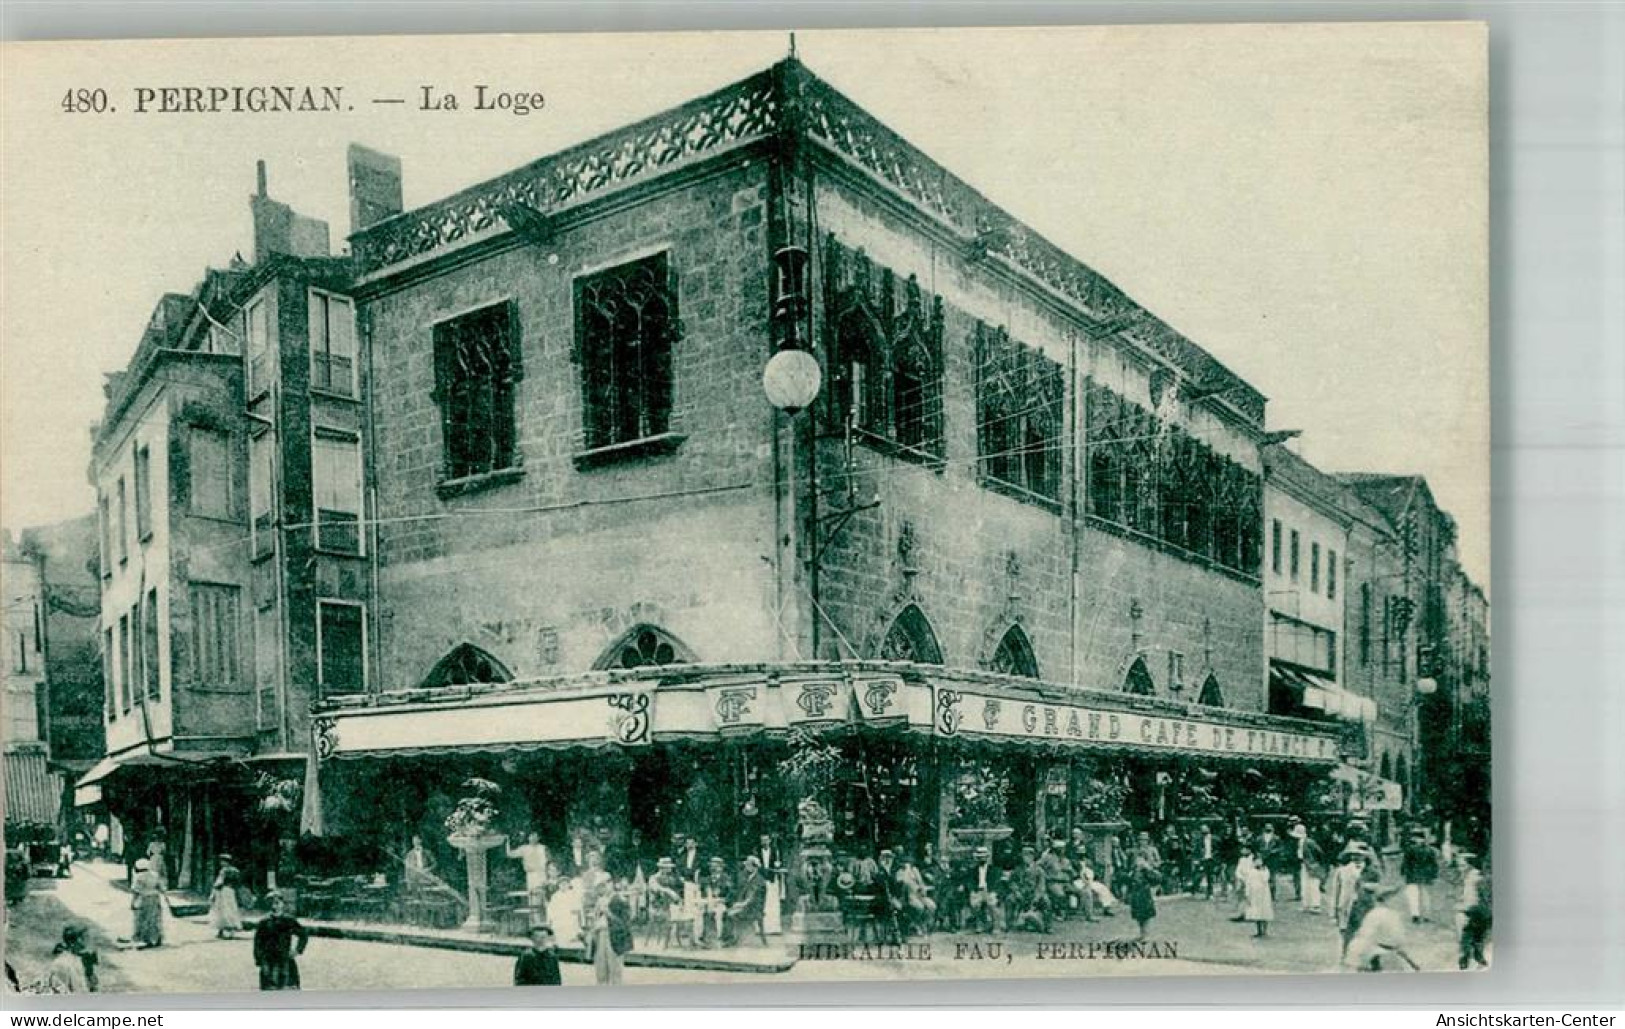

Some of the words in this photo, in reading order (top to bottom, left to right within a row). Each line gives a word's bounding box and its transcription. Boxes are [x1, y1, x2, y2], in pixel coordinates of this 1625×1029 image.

[1022, 704, 1121, 739] GRAND
[1140, 719, 1198, 746] CAFE
[1212, 727, 1235, 750] DE
